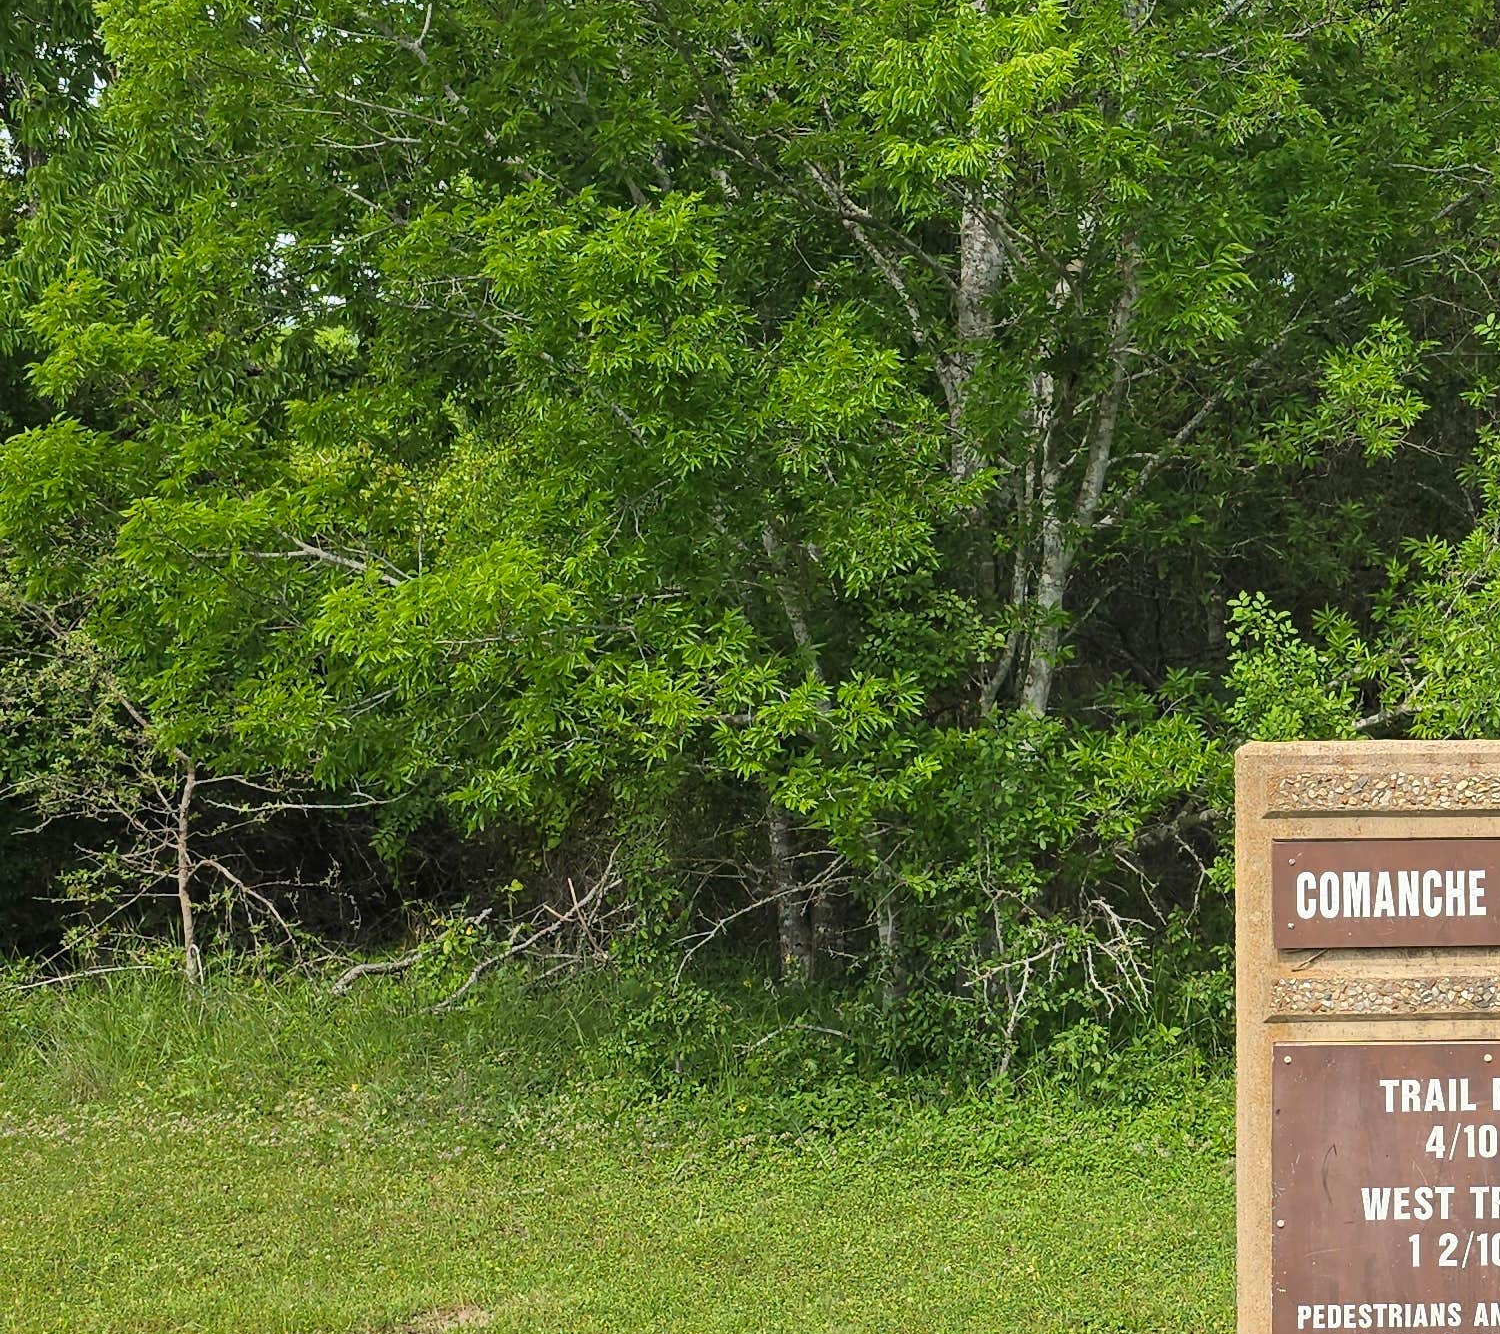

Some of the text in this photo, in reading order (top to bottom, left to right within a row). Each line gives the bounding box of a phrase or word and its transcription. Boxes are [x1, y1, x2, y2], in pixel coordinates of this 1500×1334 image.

[1297, 870, 1486, 919] COMANCHE
[1379, 1078, 1476, 1112] TRAIL
[1426, 1123, 1497, 1160] 4/10
[1361, 1186, 1455, 1220] WEST
[1409, 1234, 1420, 1267] 1
[1298, 1303, 1461, 1329] PEDESTRIANS
